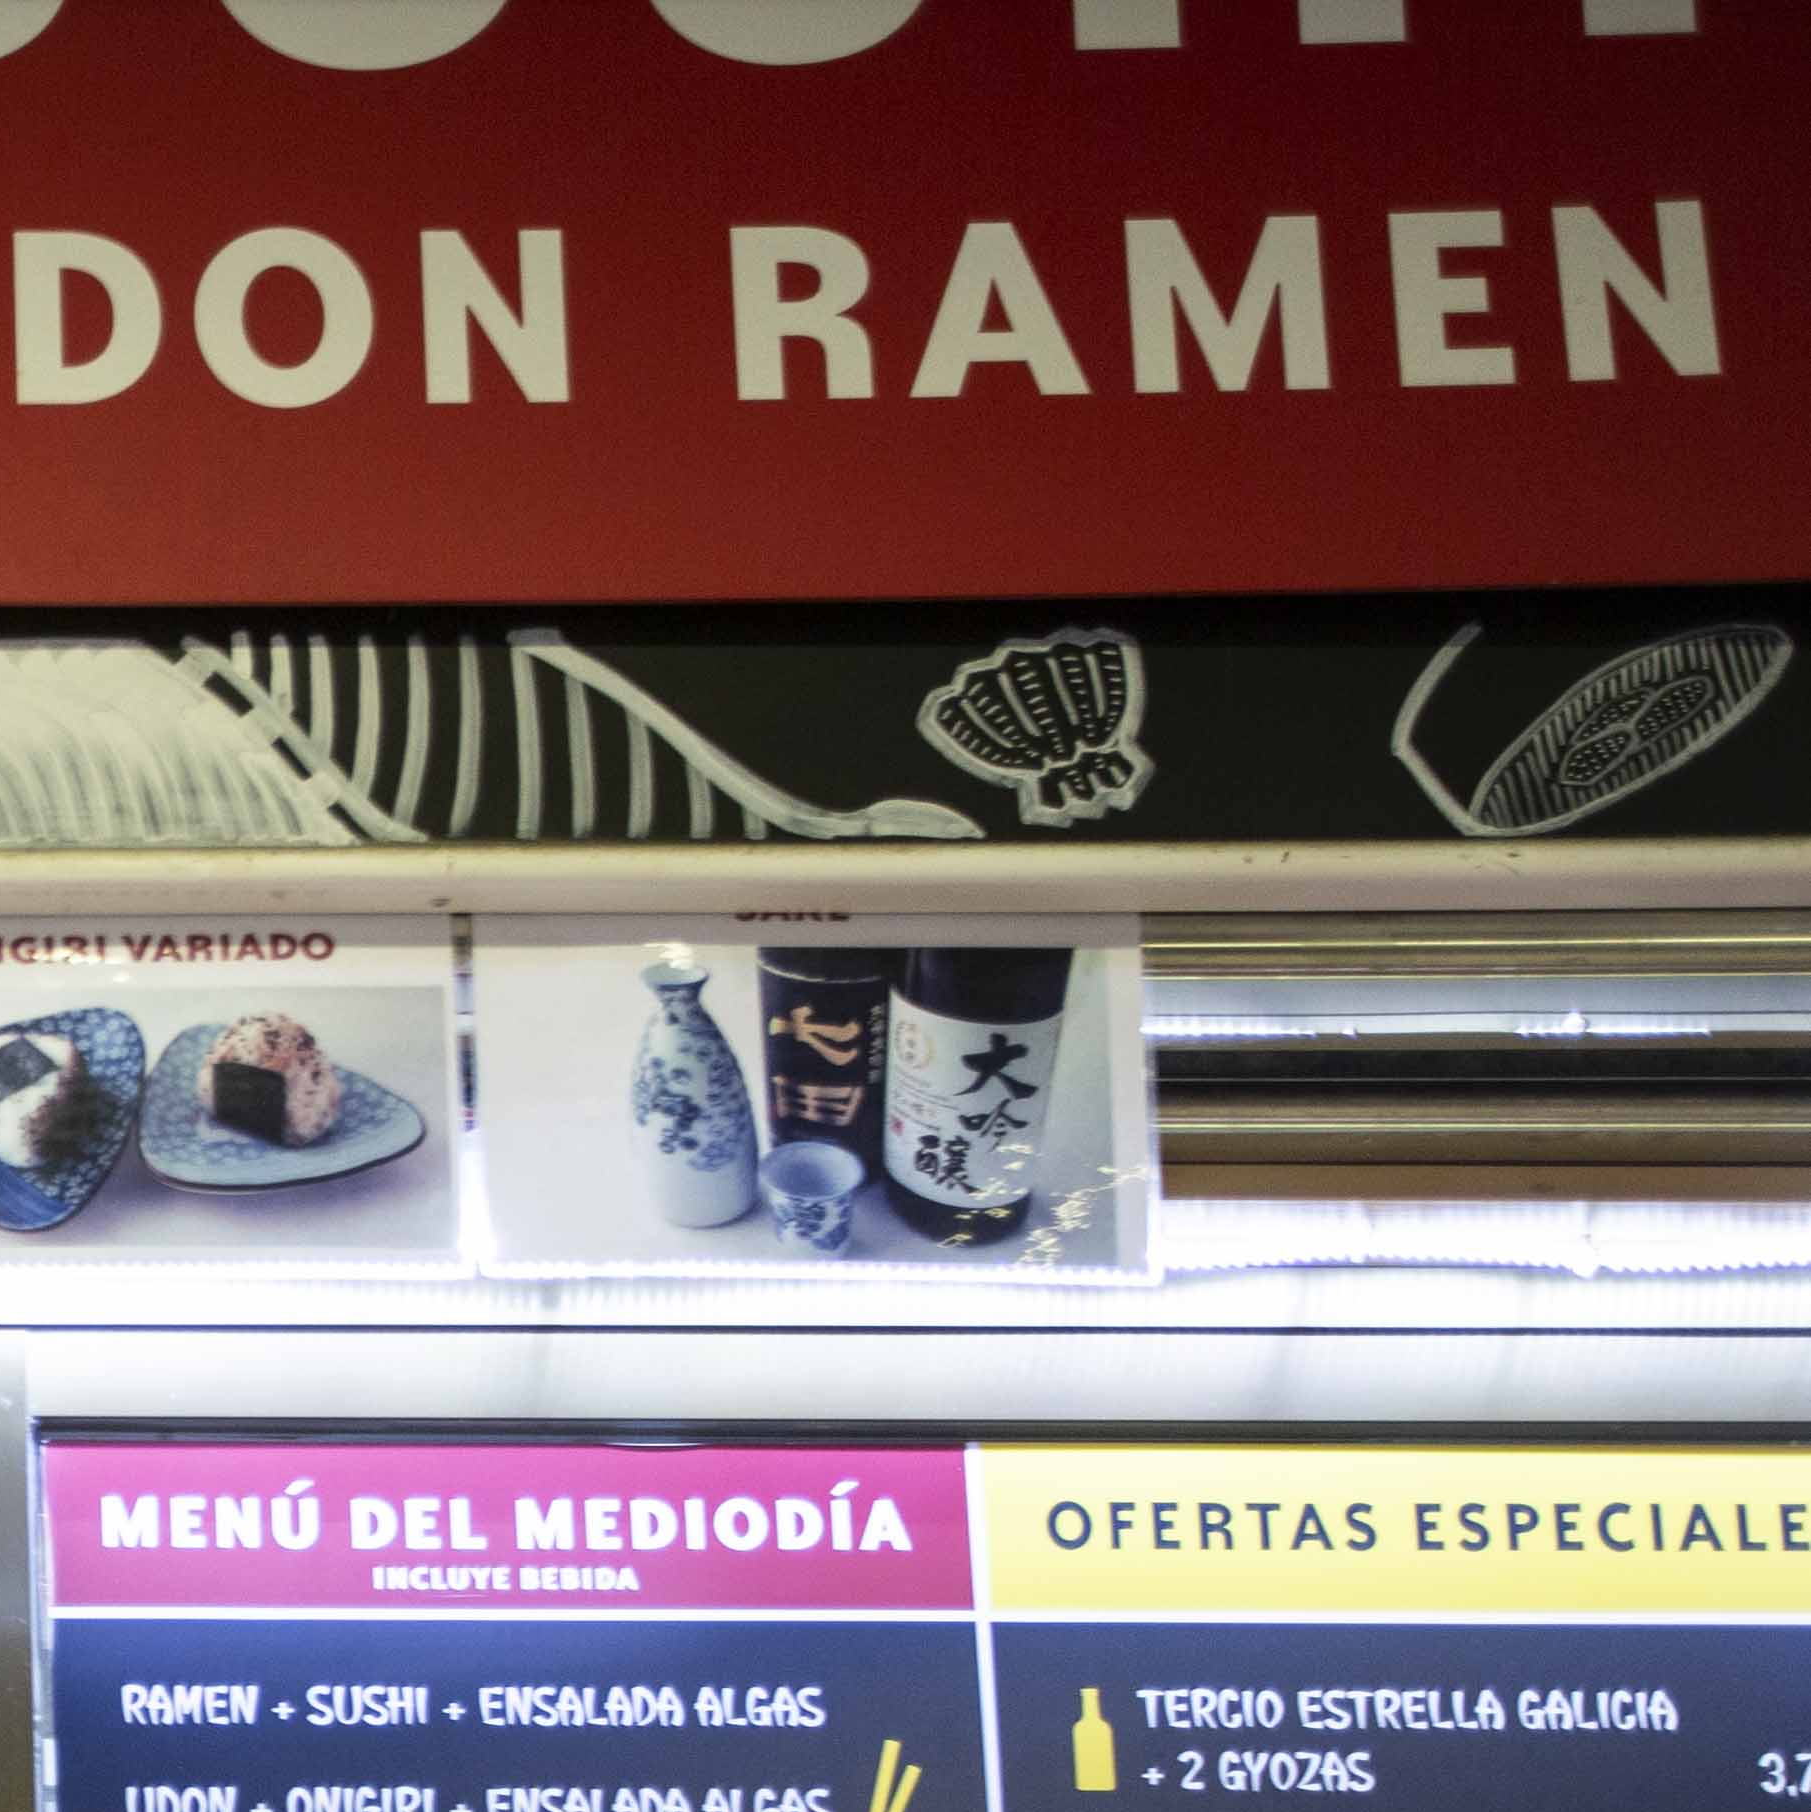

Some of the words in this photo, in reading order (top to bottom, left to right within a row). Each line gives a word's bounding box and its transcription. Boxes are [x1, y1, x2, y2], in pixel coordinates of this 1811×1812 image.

[727, 197, 1724, 403] RAMEN
[120, 930, 336, 965] VARIADO
[99, 1481, 322, 1549] MENÚ
[350, 1499, 488, 1550] DEL
[515, 1482, 911, 1552] MEDIODÍA
[1048, 1501, 1378, 1550] OFERTAS
[372, 1566, 511, 1591] INCLUYE
[519, 1567, 639, 1592] BEBIDA
[120, 1684, 260, 1726] RAMEN
[306, 1685, 429, 1726] SUSHI
[479, 1686, 685, 1728] ENSALADA
[695, 1686, 825, 1728] ALGAS
[1136, 1688, 1284, 1729] TERCIO
[1298, 1688, 1504, 1730] ESTRELLA
[1518, 1689, 1678, 1731] GALICIA
[1178, 1750, 1206, 1790] 2
[1218, 1750, 1375, 1792] GYOZAS
